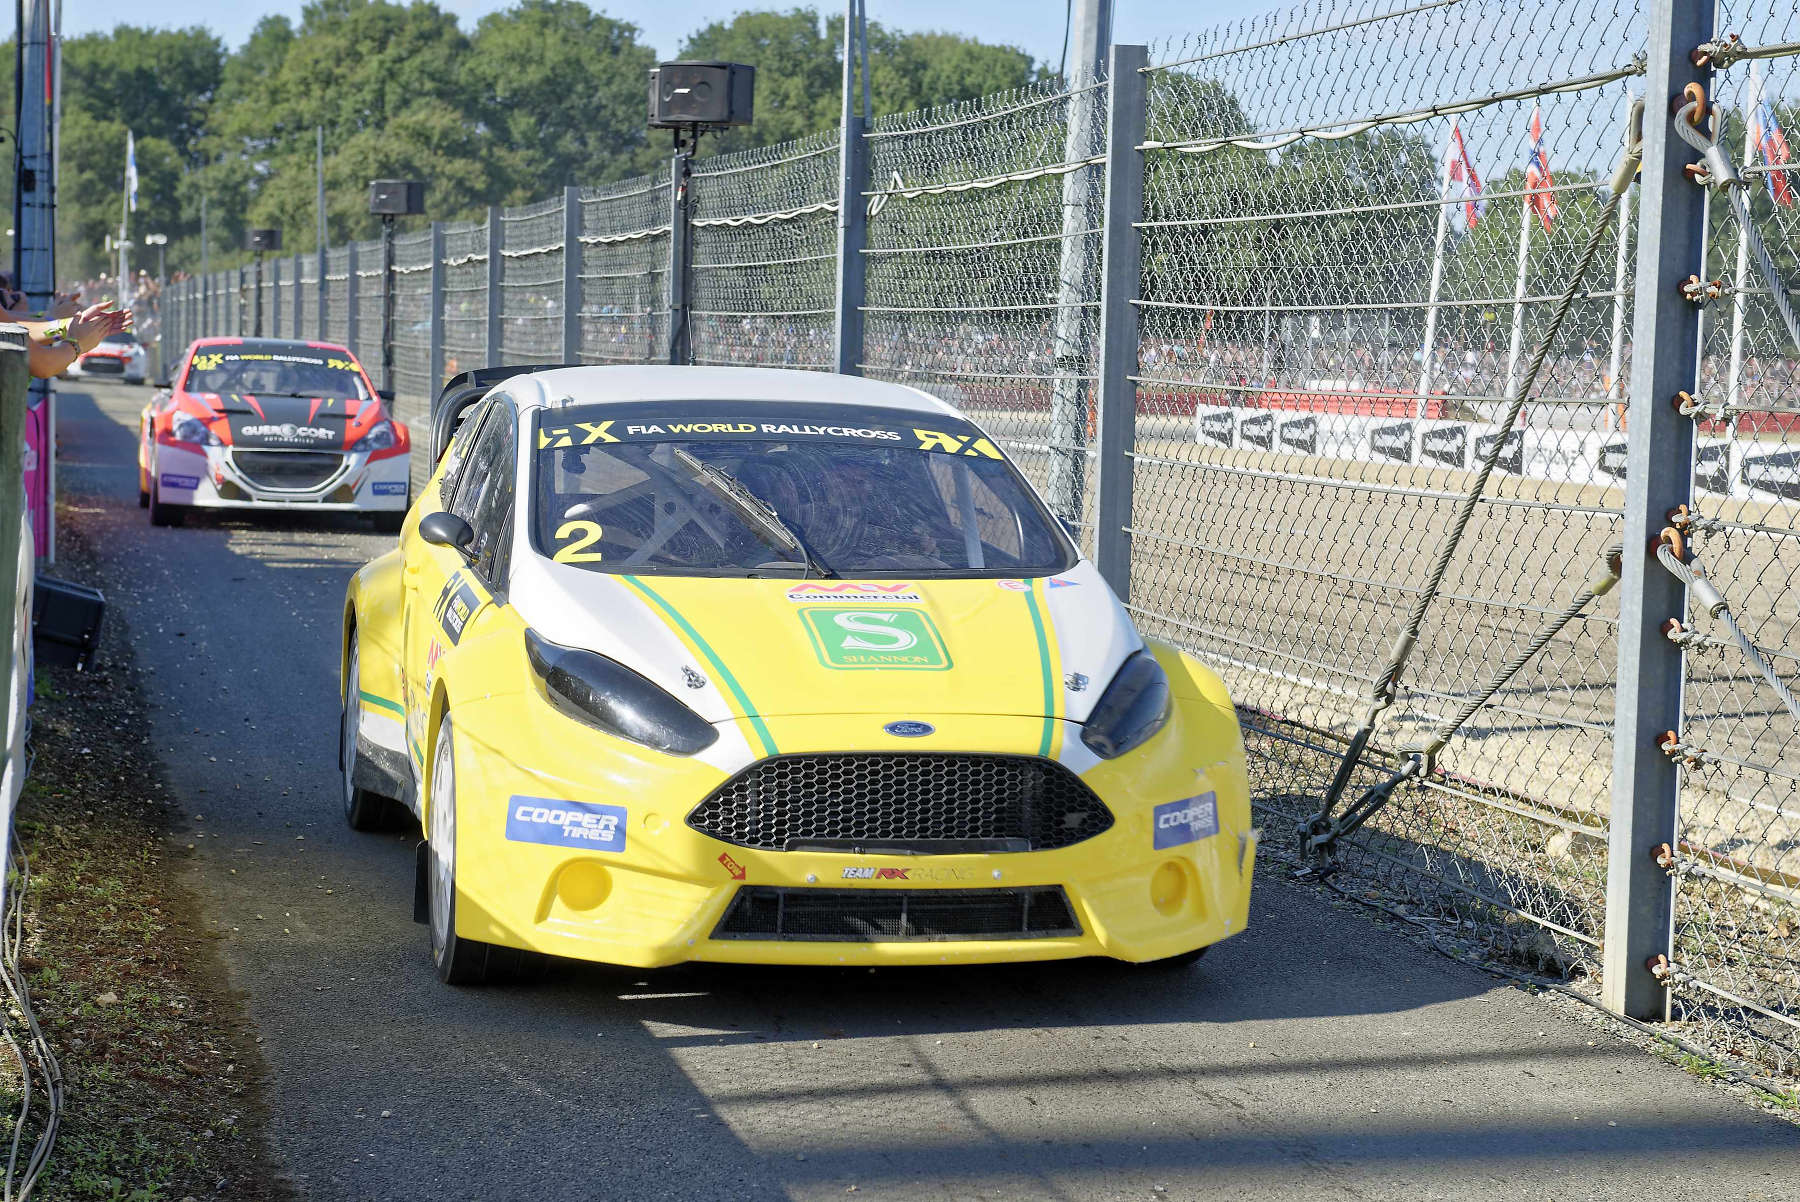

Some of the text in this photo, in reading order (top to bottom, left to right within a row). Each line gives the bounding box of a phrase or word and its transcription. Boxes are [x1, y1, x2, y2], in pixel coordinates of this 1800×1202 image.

[627, 425, 666, 435] FIA
[667, 423, 757, 434] WORLD
[760, 423, 902, 441] RALLYCROSS
[552, 520, 603, 563] 2
[833, 611, 918, 651] S
[843, 655, 929, 664] SHANNON
[515, 805, 619, 831] COOPER
[1158, 802, 1214, 829] COOPER
[562, 825, 615, 842] TIRES
[841, 867, 876, 879] TEAM
